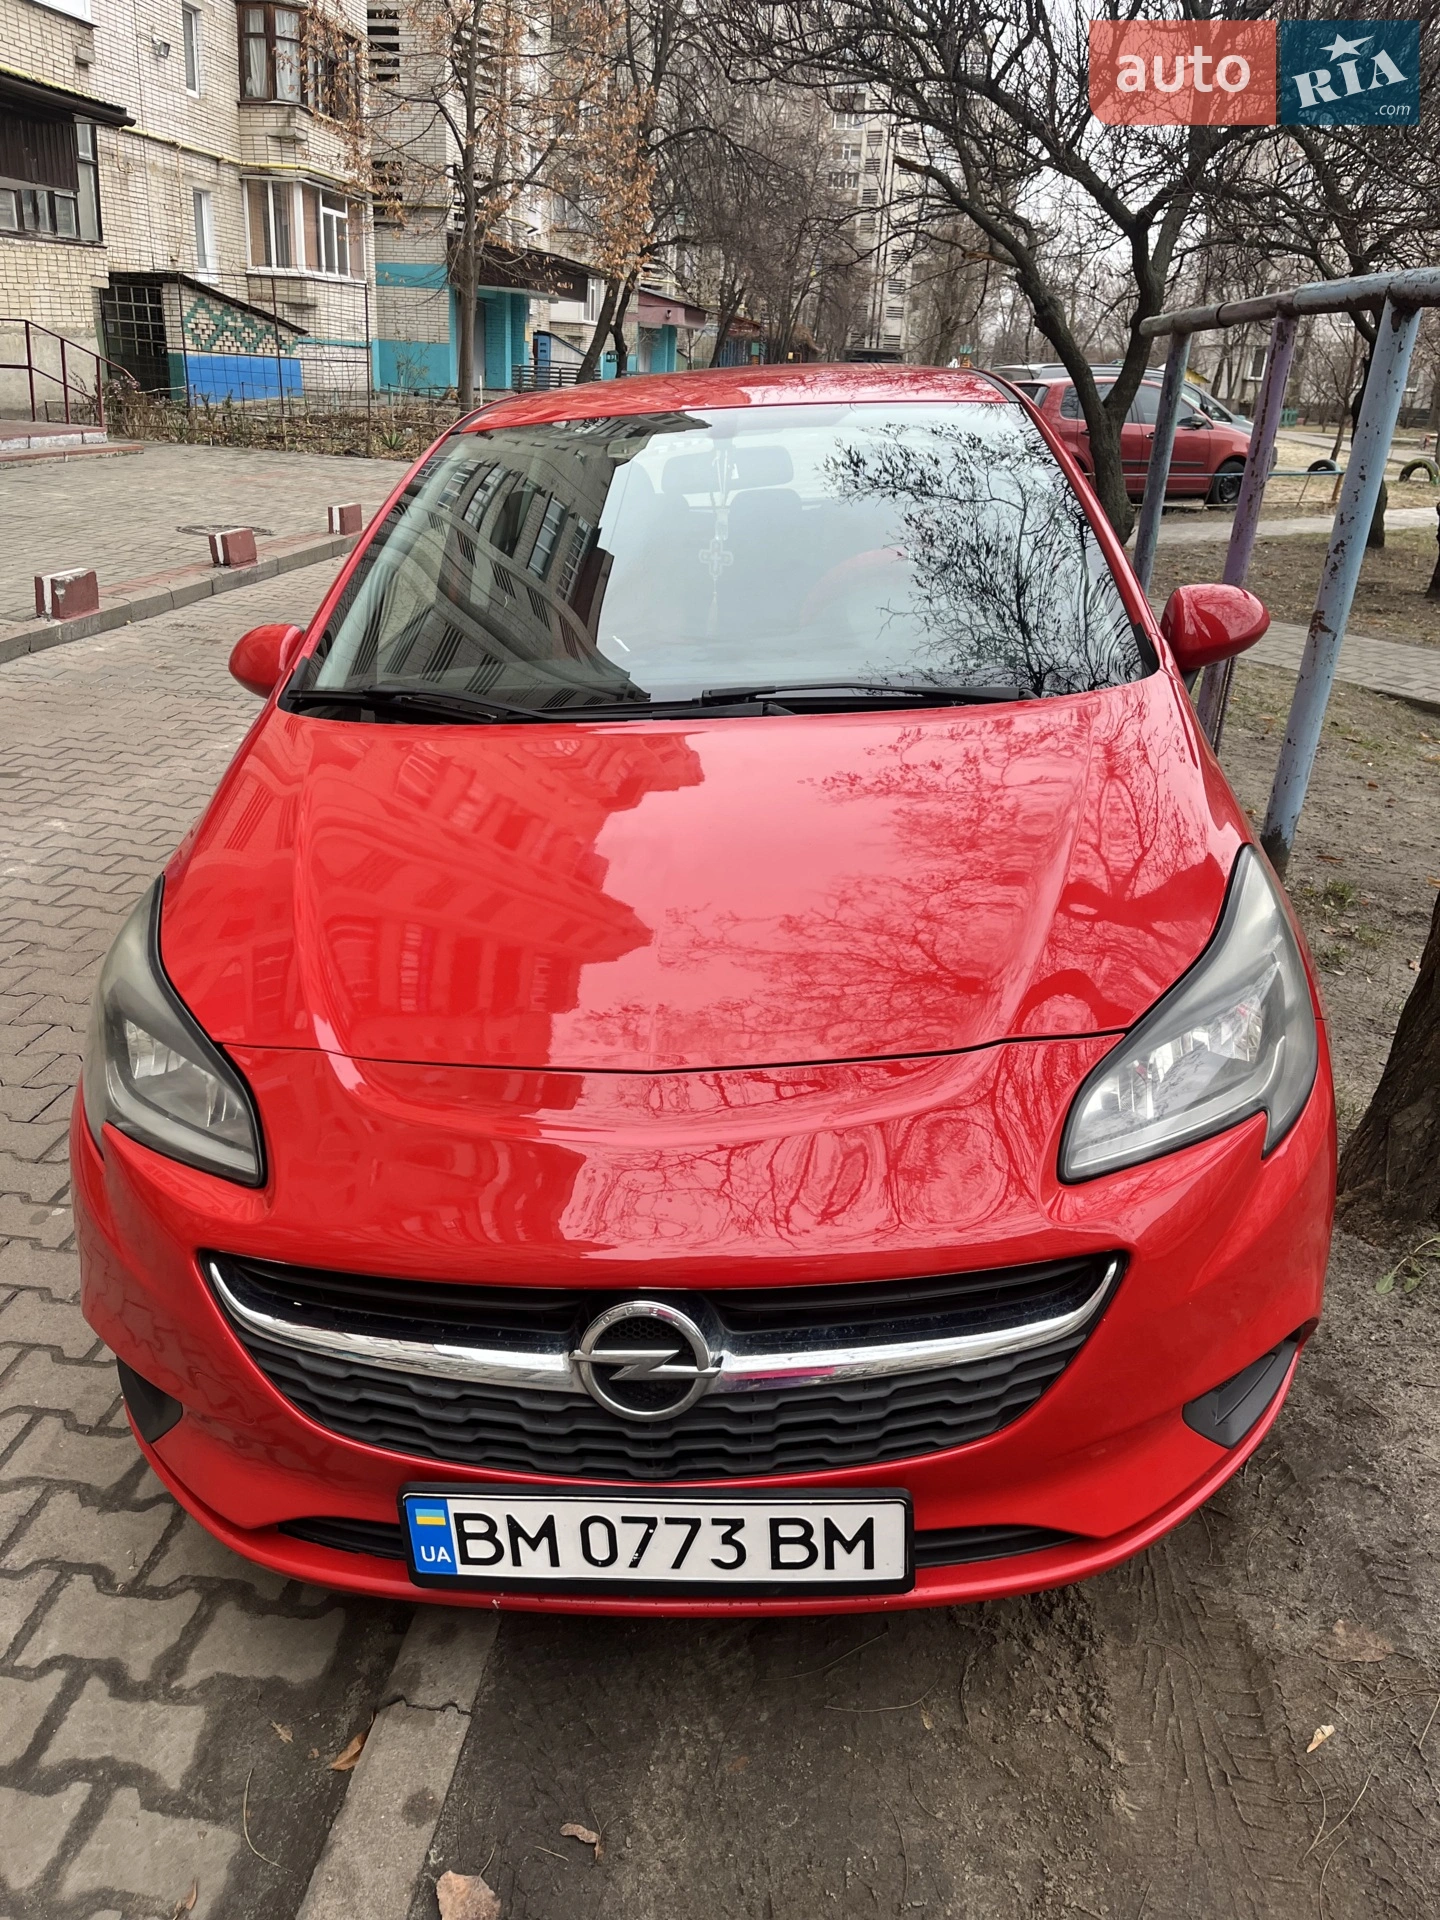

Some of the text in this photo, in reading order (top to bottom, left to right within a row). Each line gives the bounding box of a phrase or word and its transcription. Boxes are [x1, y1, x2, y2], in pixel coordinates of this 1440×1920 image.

[420, 1545, 452, 1563] UA
[453, 1512, 875, 1570] BM 0773 BM
